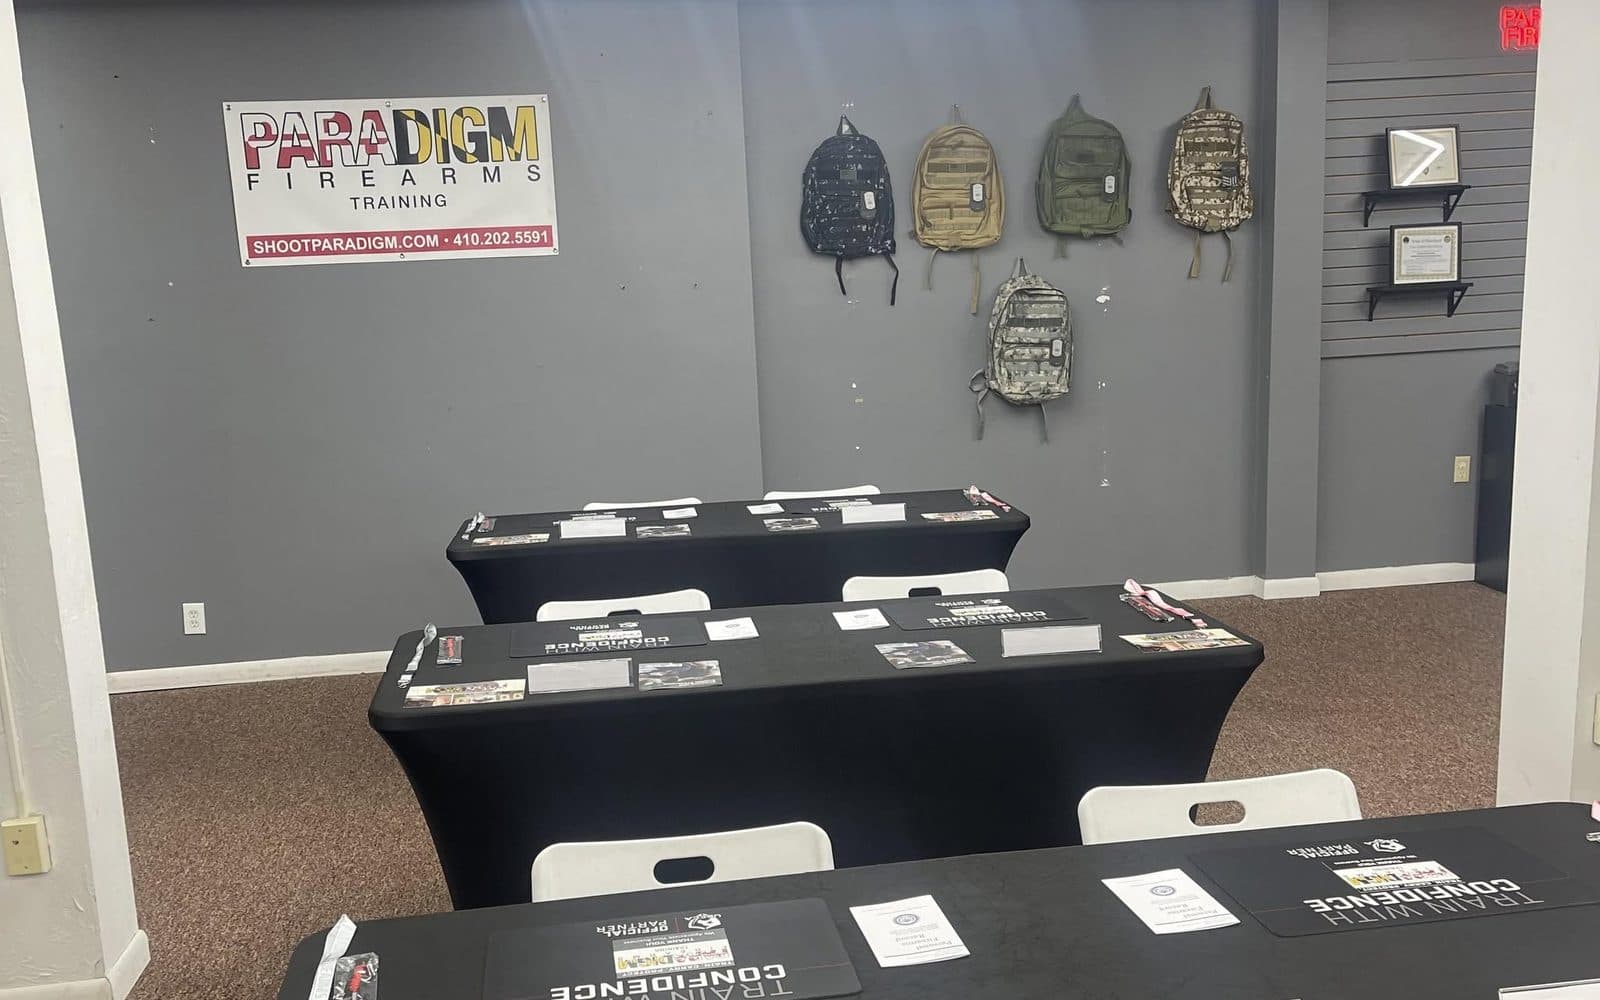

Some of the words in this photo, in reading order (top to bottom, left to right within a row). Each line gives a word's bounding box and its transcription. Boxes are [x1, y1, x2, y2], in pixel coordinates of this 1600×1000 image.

[240, 106, 540, 170] PARADIGM
[247, 165, 541, 190] FIREARMS
[350, 194, 448, 210] TRAINING
[253, 234, 439, 255] SHOOTPARADIGM.COM
[453, 230, 549, 247] 410.202.5591
[545, 637, 669, 650] CONFIDENCE
[1304, 878, 1520, 912] CONFIDENCE
[1424, 892, 1544, 914] TRAIN
[1321, 904, 1423, 925] WITH
[597, 920, 667, 933] PARTNER
[603, 925, 669, 937] OFFICIAL
[550, 964, 787, 1000] CONFIDENCE
[671, 980, 794, 1000] TRAIN
